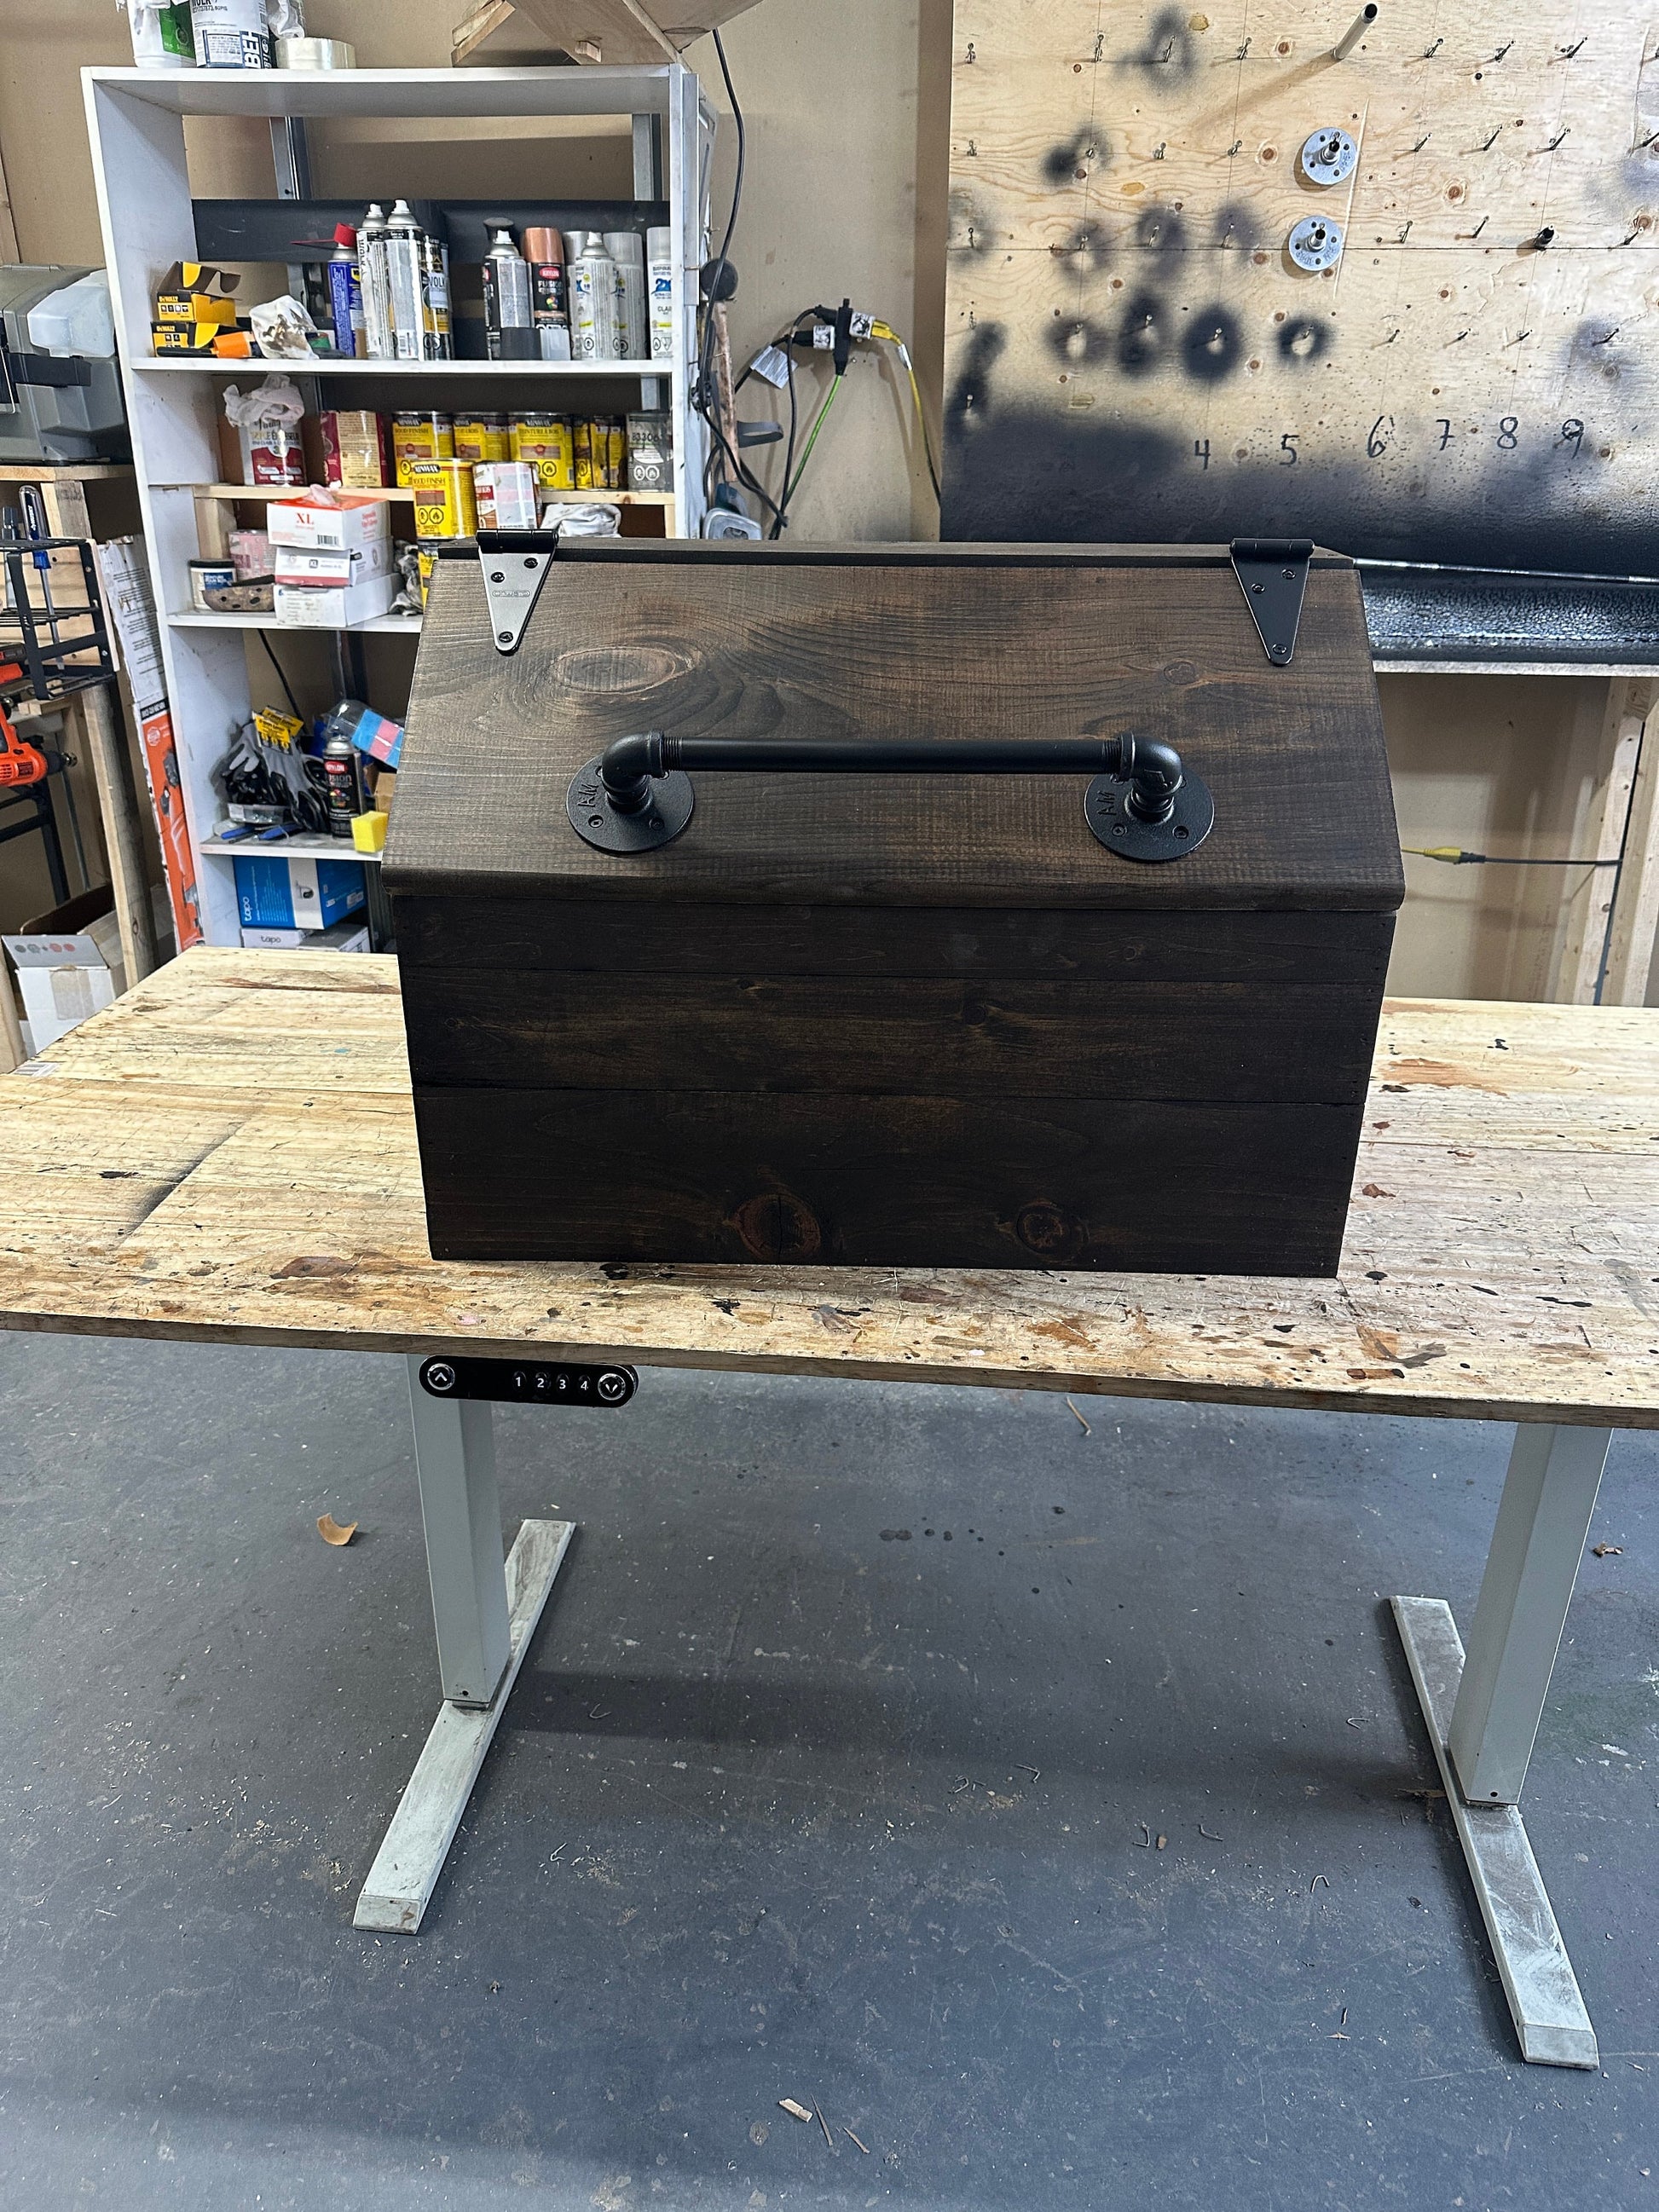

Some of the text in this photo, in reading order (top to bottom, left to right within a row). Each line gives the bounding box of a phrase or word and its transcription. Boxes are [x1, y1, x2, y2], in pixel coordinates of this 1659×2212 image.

[244, 31, 260, 68] BEH
[1194, 416, 1585, 469] 4 5 6 7 8 9
[296, 512, 315, 525] XL
[515, 1376, 588, 1390] 1 2 3 4
